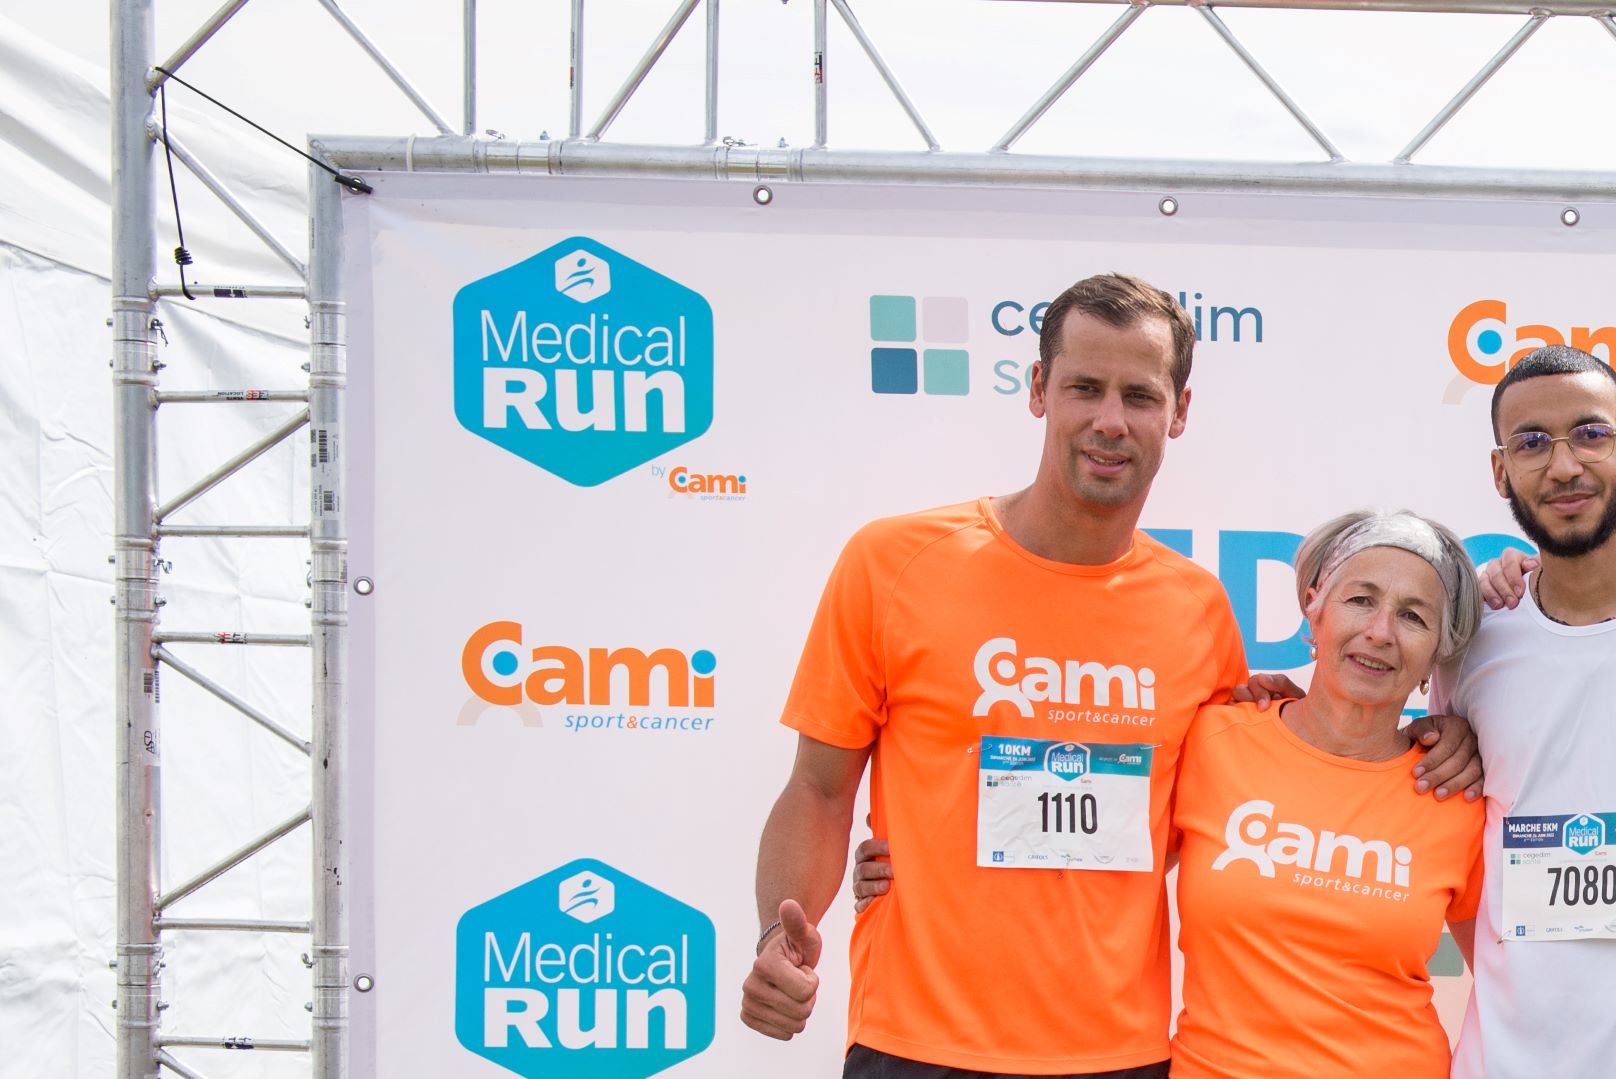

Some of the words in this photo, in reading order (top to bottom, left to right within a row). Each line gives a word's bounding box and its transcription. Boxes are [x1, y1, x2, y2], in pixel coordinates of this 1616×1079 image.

[481, 310, 685, 367] Medical
[482, 368, 686, 433] Run
[651, 464, 666, 478] by
[669, 466, 746, 494] Cami
[462, 621, 717, 707] Cami
[973, 637, 1156, 714] Cami
[565, 711, 713, 732] sport&cancer
[1048, 708, 1155, 726] sport&cancer
[998, 743, 1031, 756] 10KM
[1051, 752, 1084, 763] Medical
[1051, 762, 1084, 774] Run
[1037, 792, 1098, 835] 1110
[1508, 823, 1541, 833] MARCHE
[1543, 823, 1559, 832] 5KM
[1223, 799, 1413, 888] Cami
[1568, 826, 1599, 837] Medical
[1568, 835, 1598, 847] Run
[1294, 873, 1410, 903] sport&cancer
[483, 931, 687, 984] Medical
[483, 987, 687, 1050] Run
